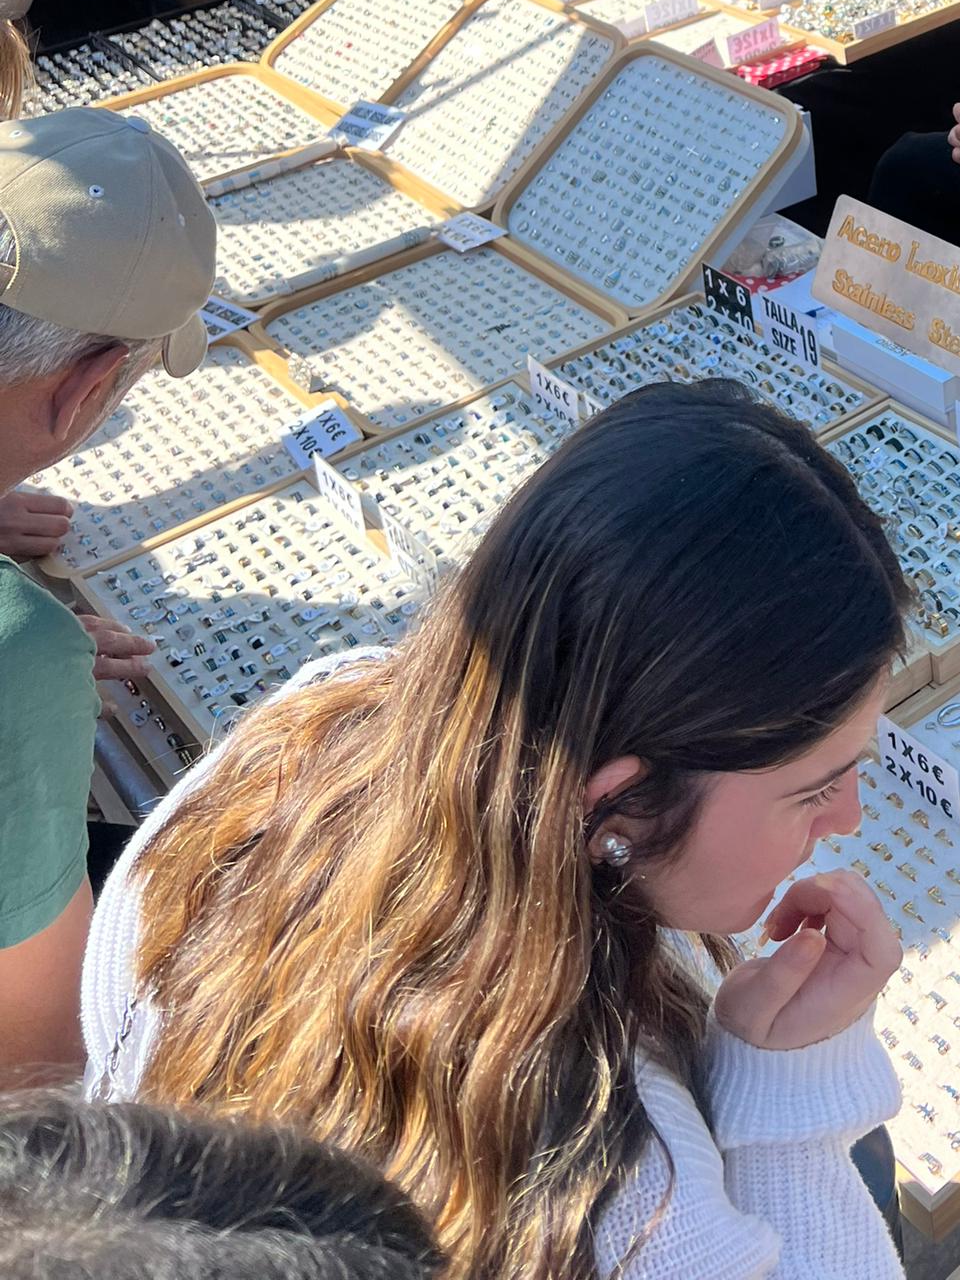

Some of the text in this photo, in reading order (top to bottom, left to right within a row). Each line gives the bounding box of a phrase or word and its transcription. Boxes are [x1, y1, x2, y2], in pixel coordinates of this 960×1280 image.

[837, 214, 902, 263] Acero
[705, 268, 713, 289] 1
[736, 285, 746, 306] 6
[832, 268, 916, 332] Stainless
[762, 295, 800, 334] TALLA
[771, 327, 798, 357] SIZE
[800, 325, 818, 366] 19
[888, 732, 944, 786] 1X6€
[885, 755, 953, 819] 2X10€
